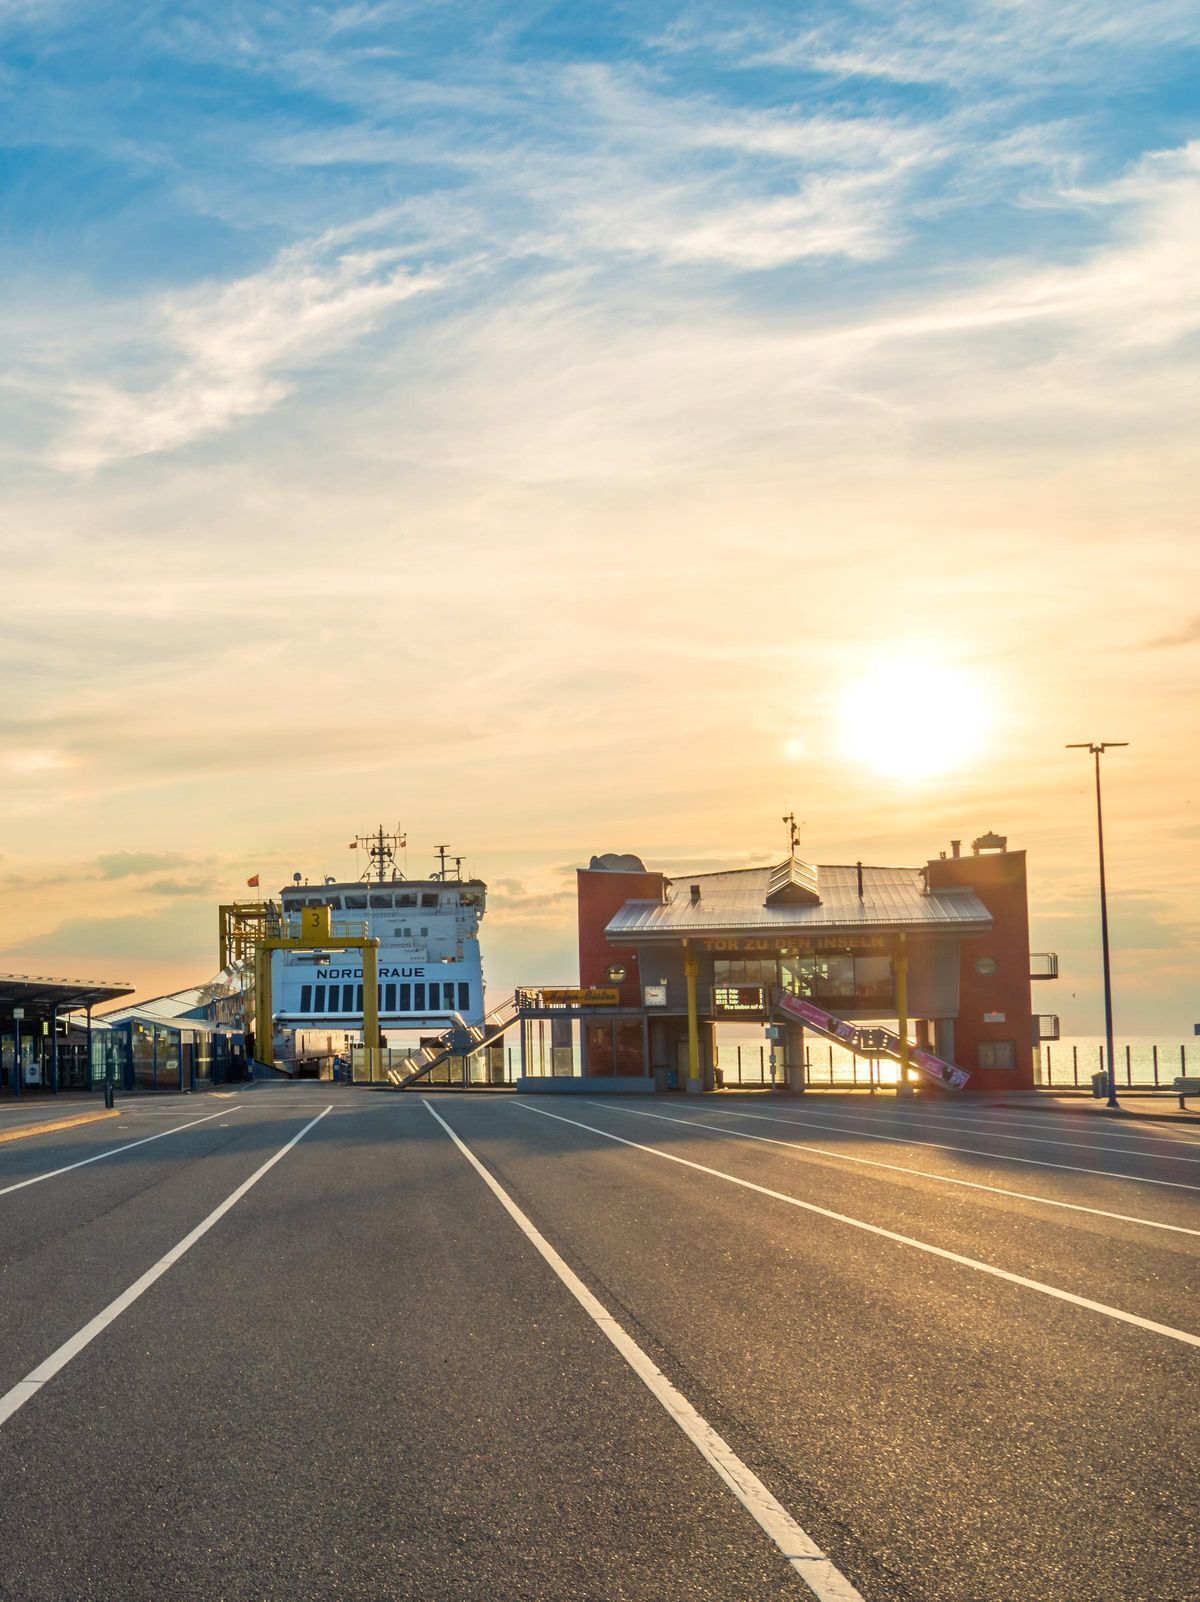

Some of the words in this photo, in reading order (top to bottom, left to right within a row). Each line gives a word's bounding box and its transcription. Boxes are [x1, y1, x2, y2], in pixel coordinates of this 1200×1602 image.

[311, 912, 320, 928] 3
[704, 939, 738, 951] TOR
[744, 938, 769, 951] ZU
[775, 938, 810, 949] DEN
[818, 936, 885, 948] INSELN
[316, 967, 425, 979] NORDRAUE
